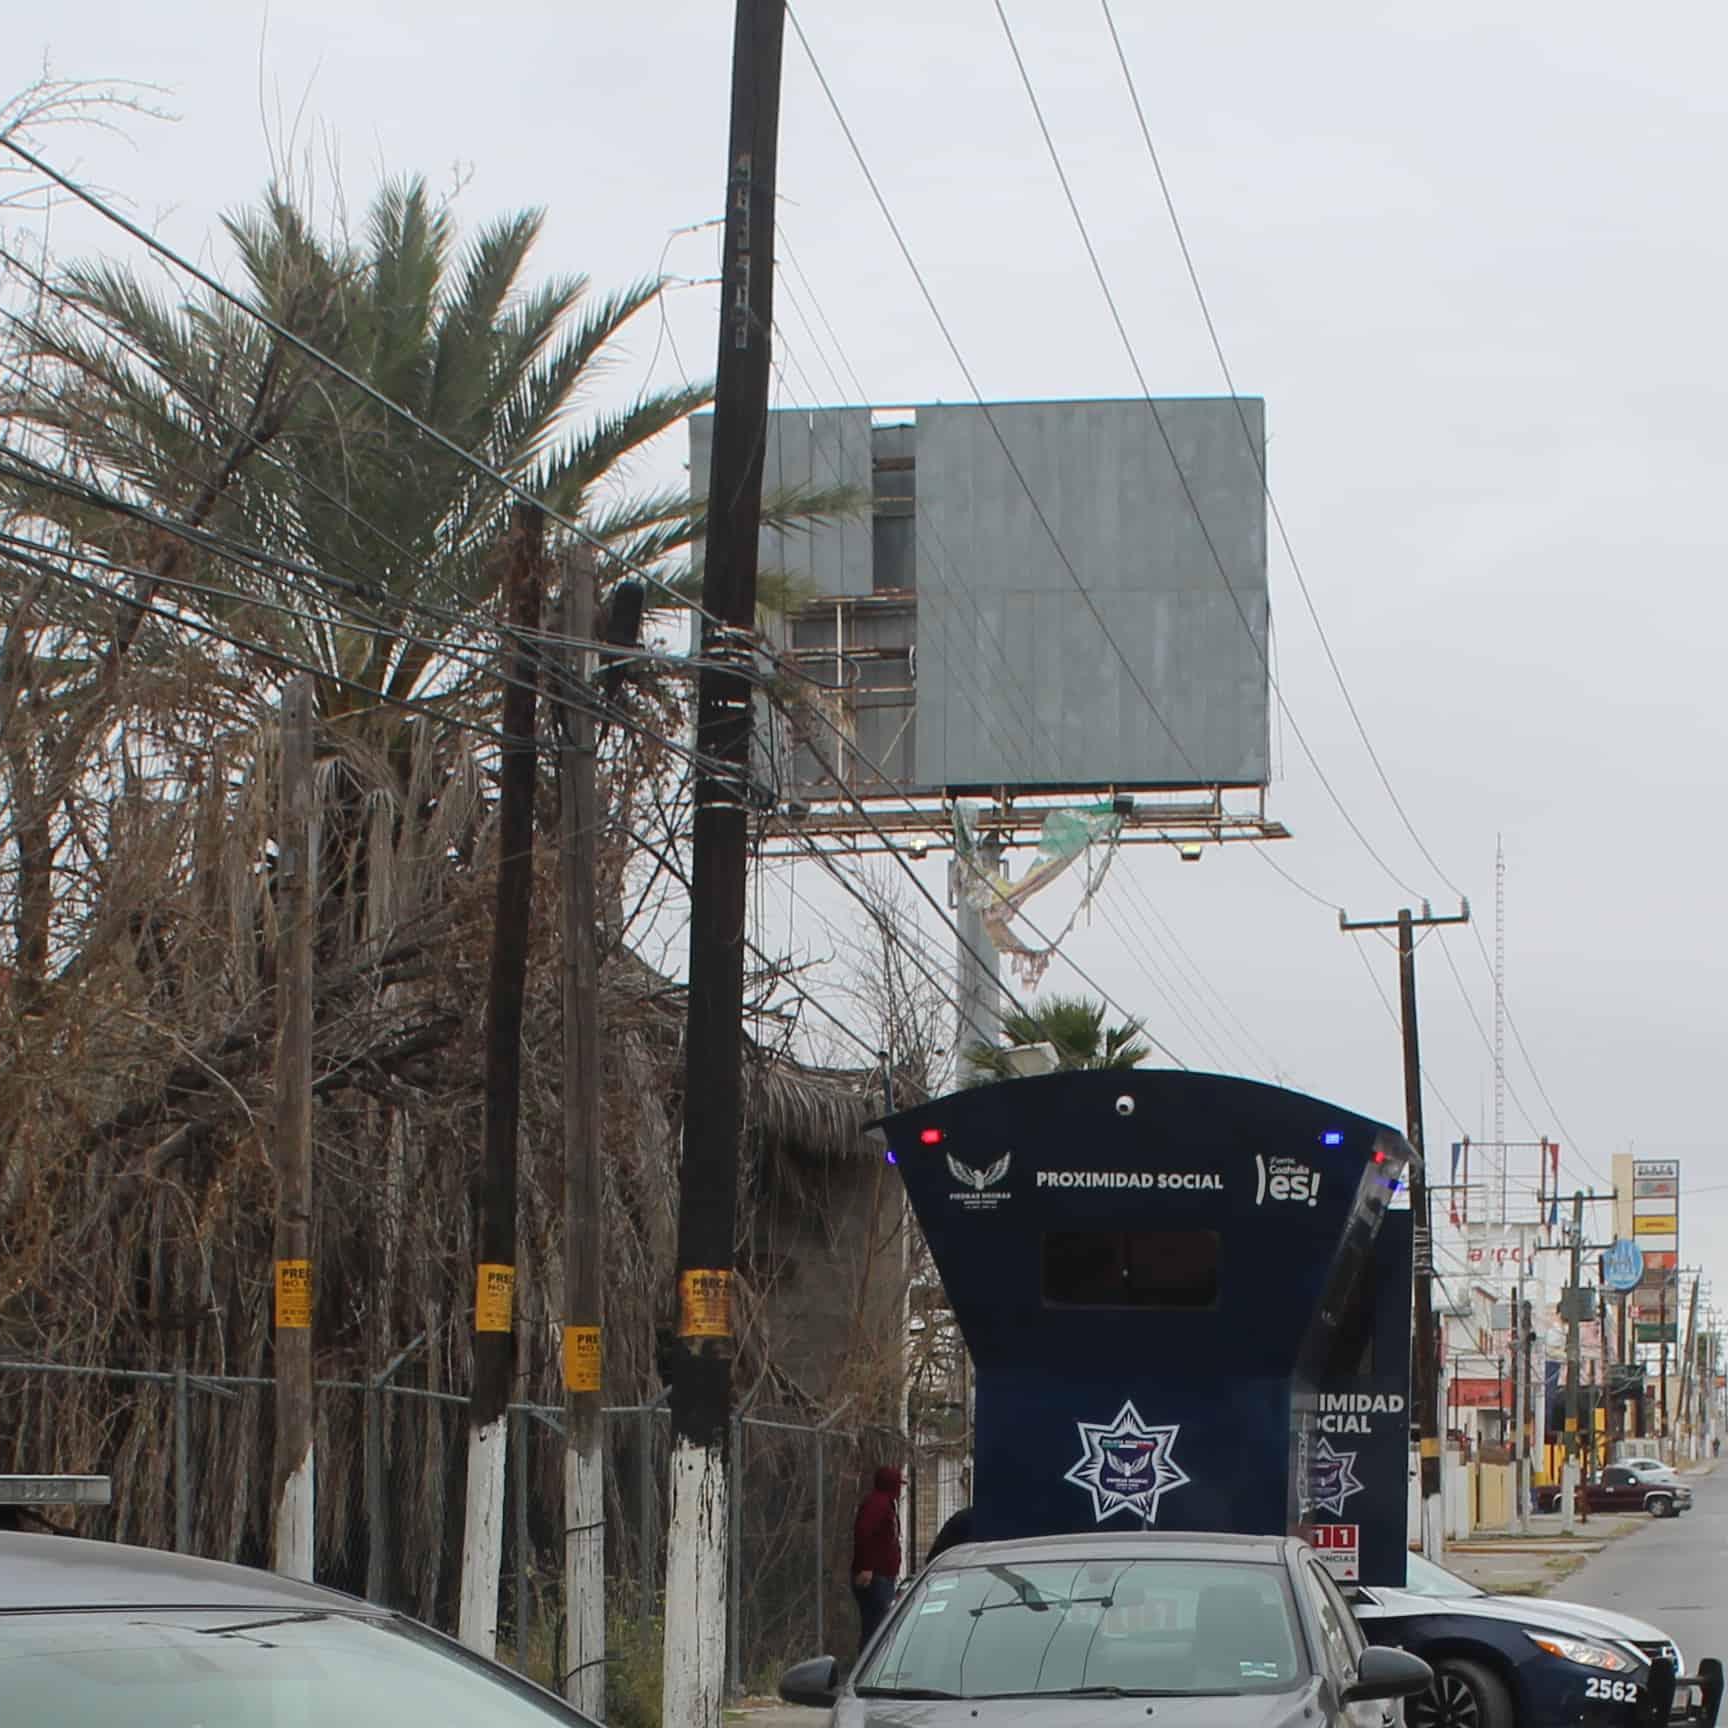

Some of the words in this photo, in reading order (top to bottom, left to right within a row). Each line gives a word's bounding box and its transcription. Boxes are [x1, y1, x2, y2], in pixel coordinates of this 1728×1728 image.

[1036, 1170, 1153, 1189] PROXIMIDAD
[1157, 1173, 1223, 1189] SOCIAL
[1320, 1394, 1404, 1413] IMIDAD
[1318, 1415, 1371, 1433] CIAL
[1585, 1677, 1637, 1703] 2562
